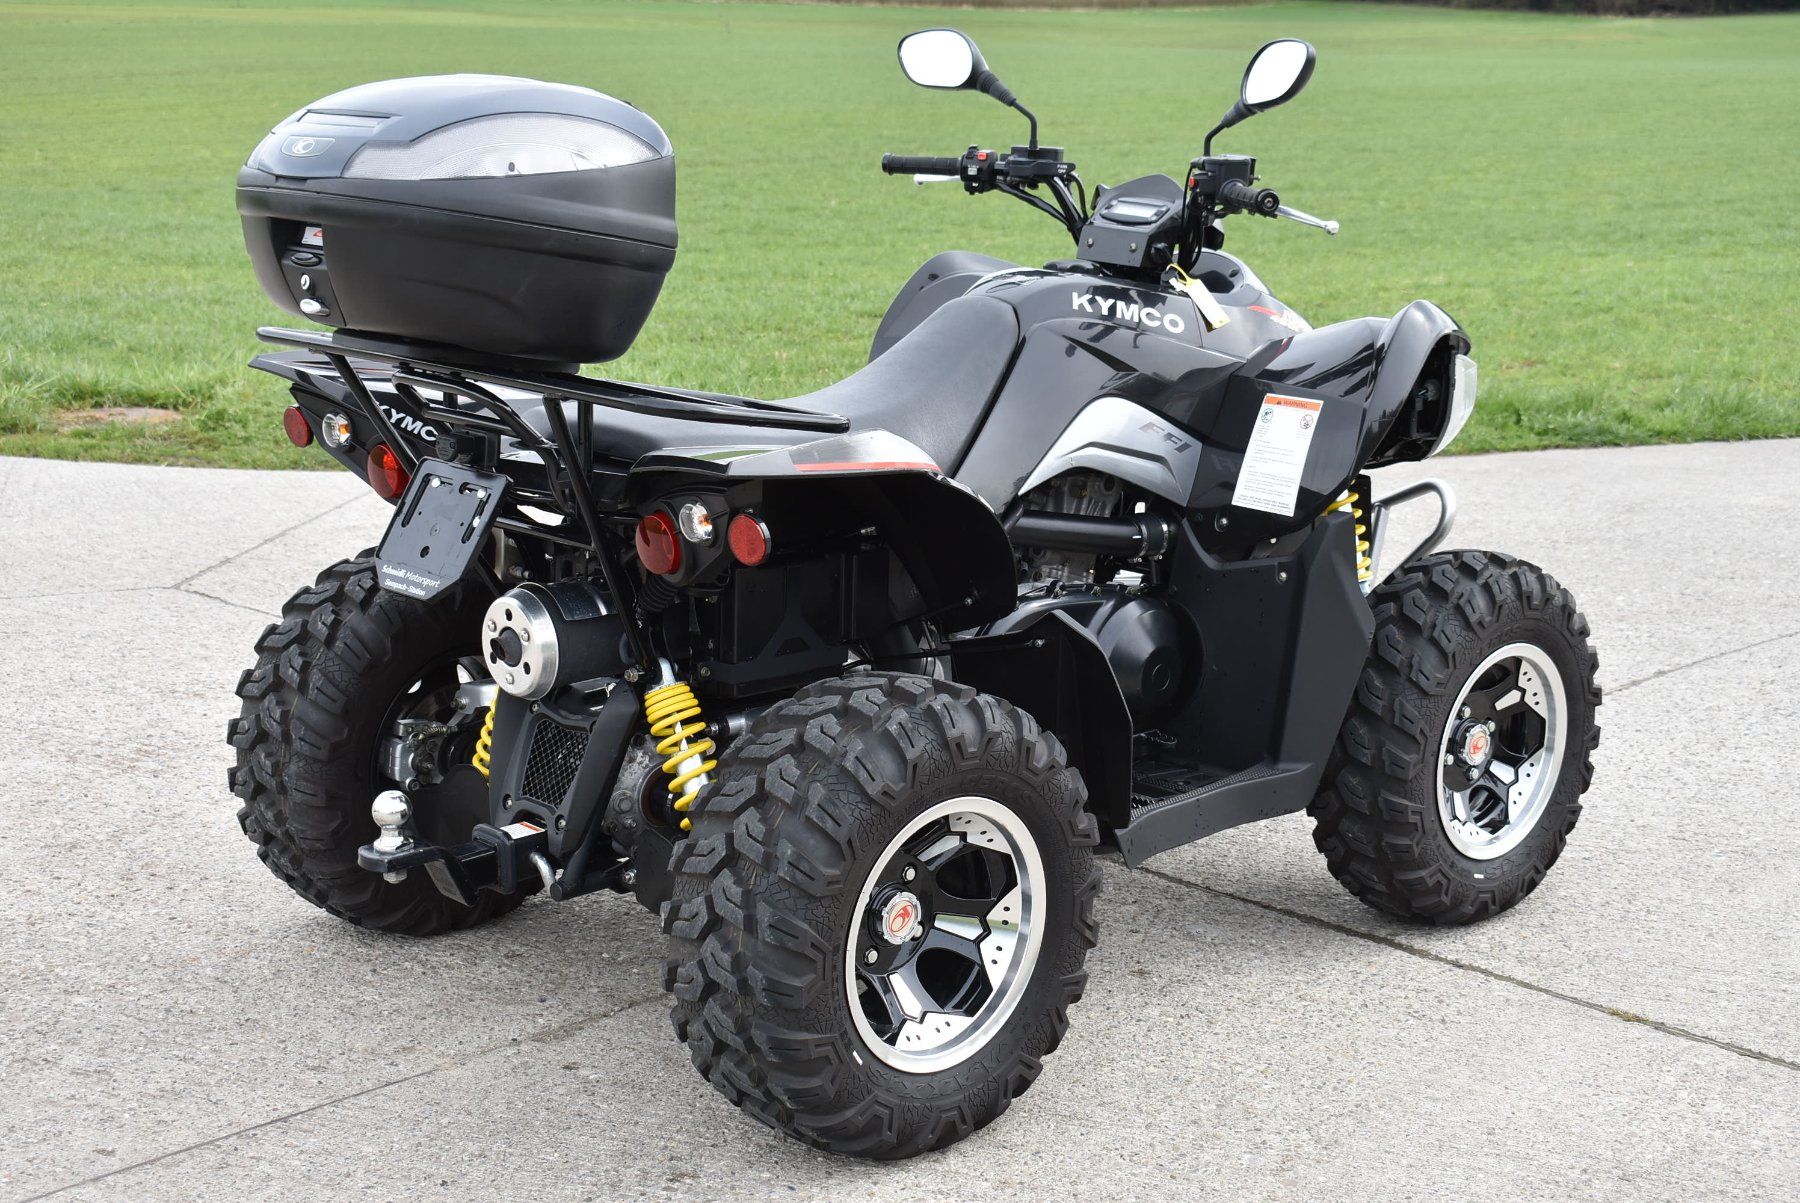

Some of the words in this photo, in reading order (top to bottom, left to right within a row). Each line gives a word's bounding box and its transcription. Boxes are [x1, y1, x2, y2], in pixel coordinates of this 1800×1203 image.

[1072, 292, 1185, 334] KYMCO
[1283, 400, 1308, 409] WARNING
[380, 405, 439, 441] YMC
[405, 571, 440, 588] Motorsport
